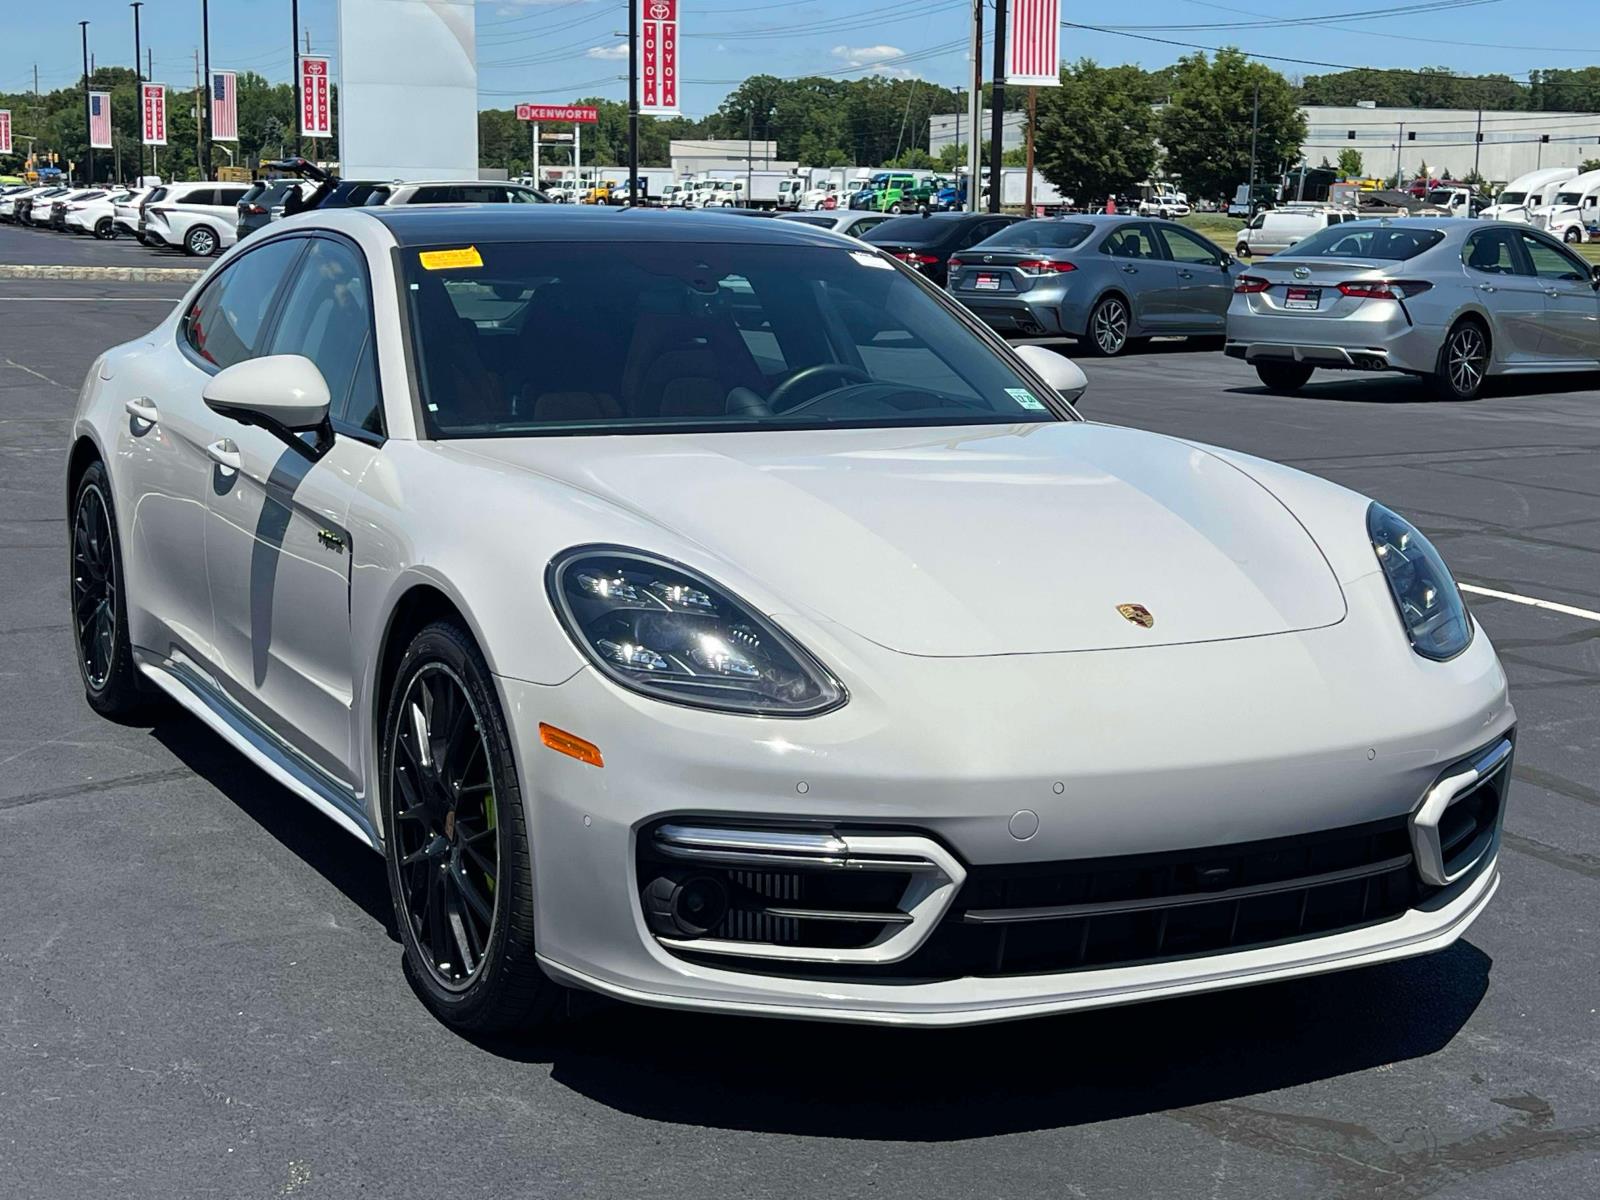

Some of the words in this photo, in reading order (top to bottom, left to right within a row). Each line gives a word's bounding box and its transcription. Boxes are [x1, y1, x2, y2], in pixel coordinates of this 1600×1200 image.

[646, 26, 654, 103] TOYOTA
[665, 26, 673, 104] TOYOTA
[531, 108, 597, 120] KENWORTH
